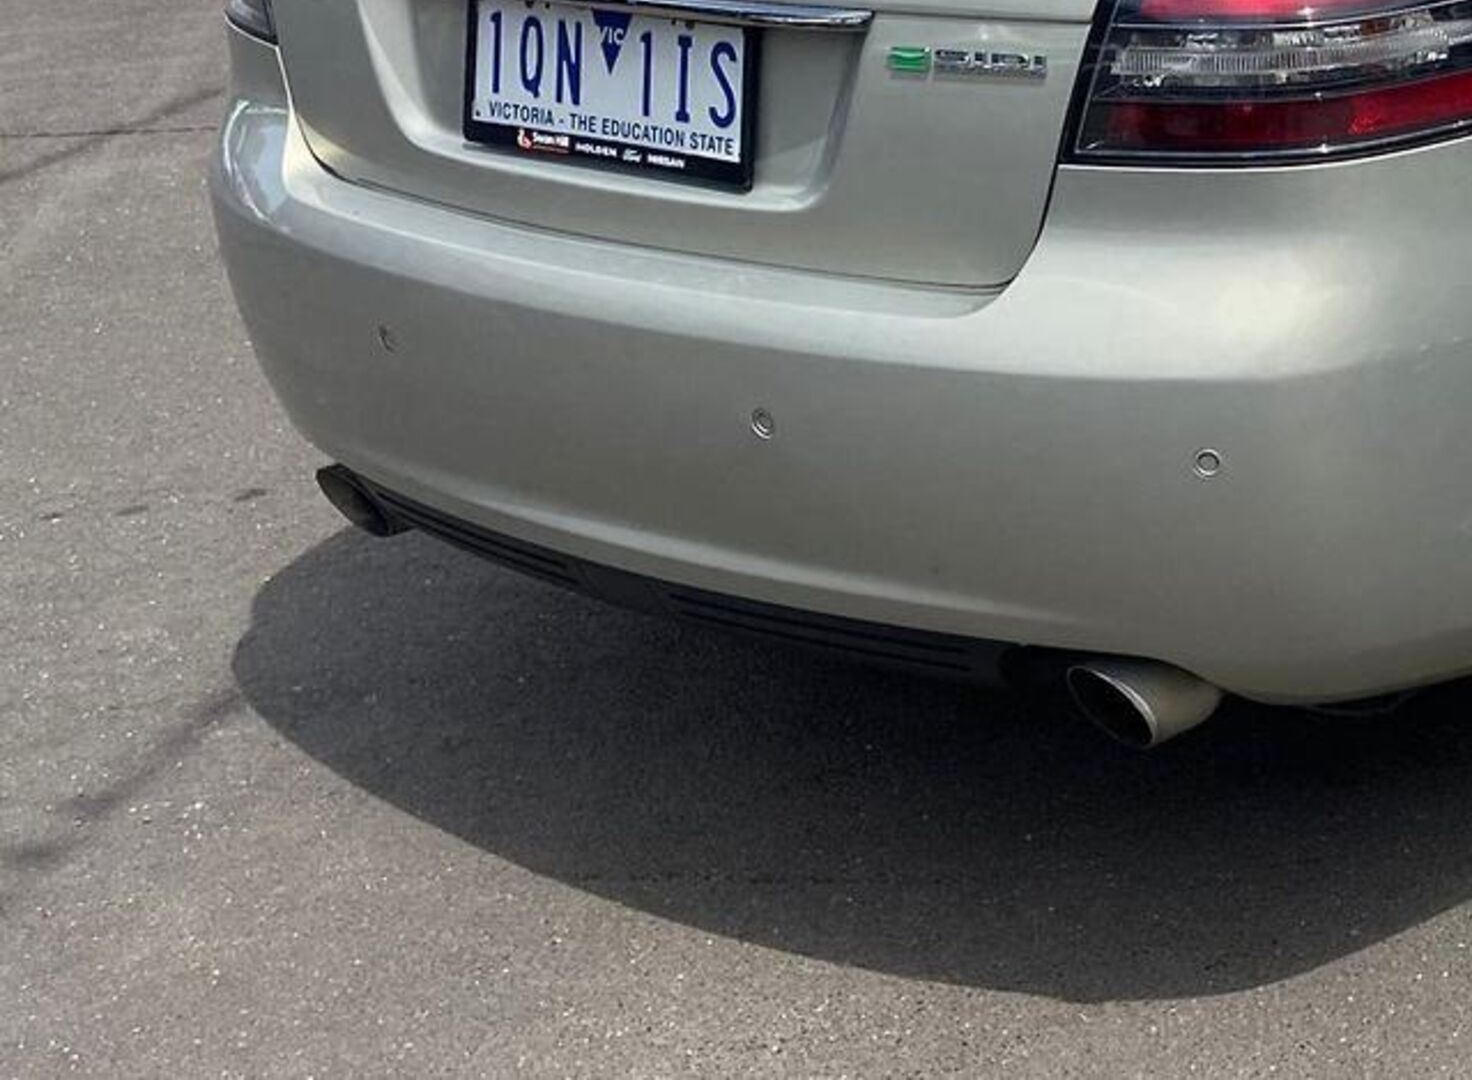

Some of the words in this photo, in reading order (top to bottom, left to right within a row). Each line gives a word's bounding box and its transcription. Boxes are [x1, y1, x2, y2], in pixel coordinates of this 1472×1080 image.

[488, 100, 556, 127] VICTORIA
[570, 113, 598, 135] THE
[601, 118, 686, 148] EDUCATION
[688, 133, 736, 157] STATE
